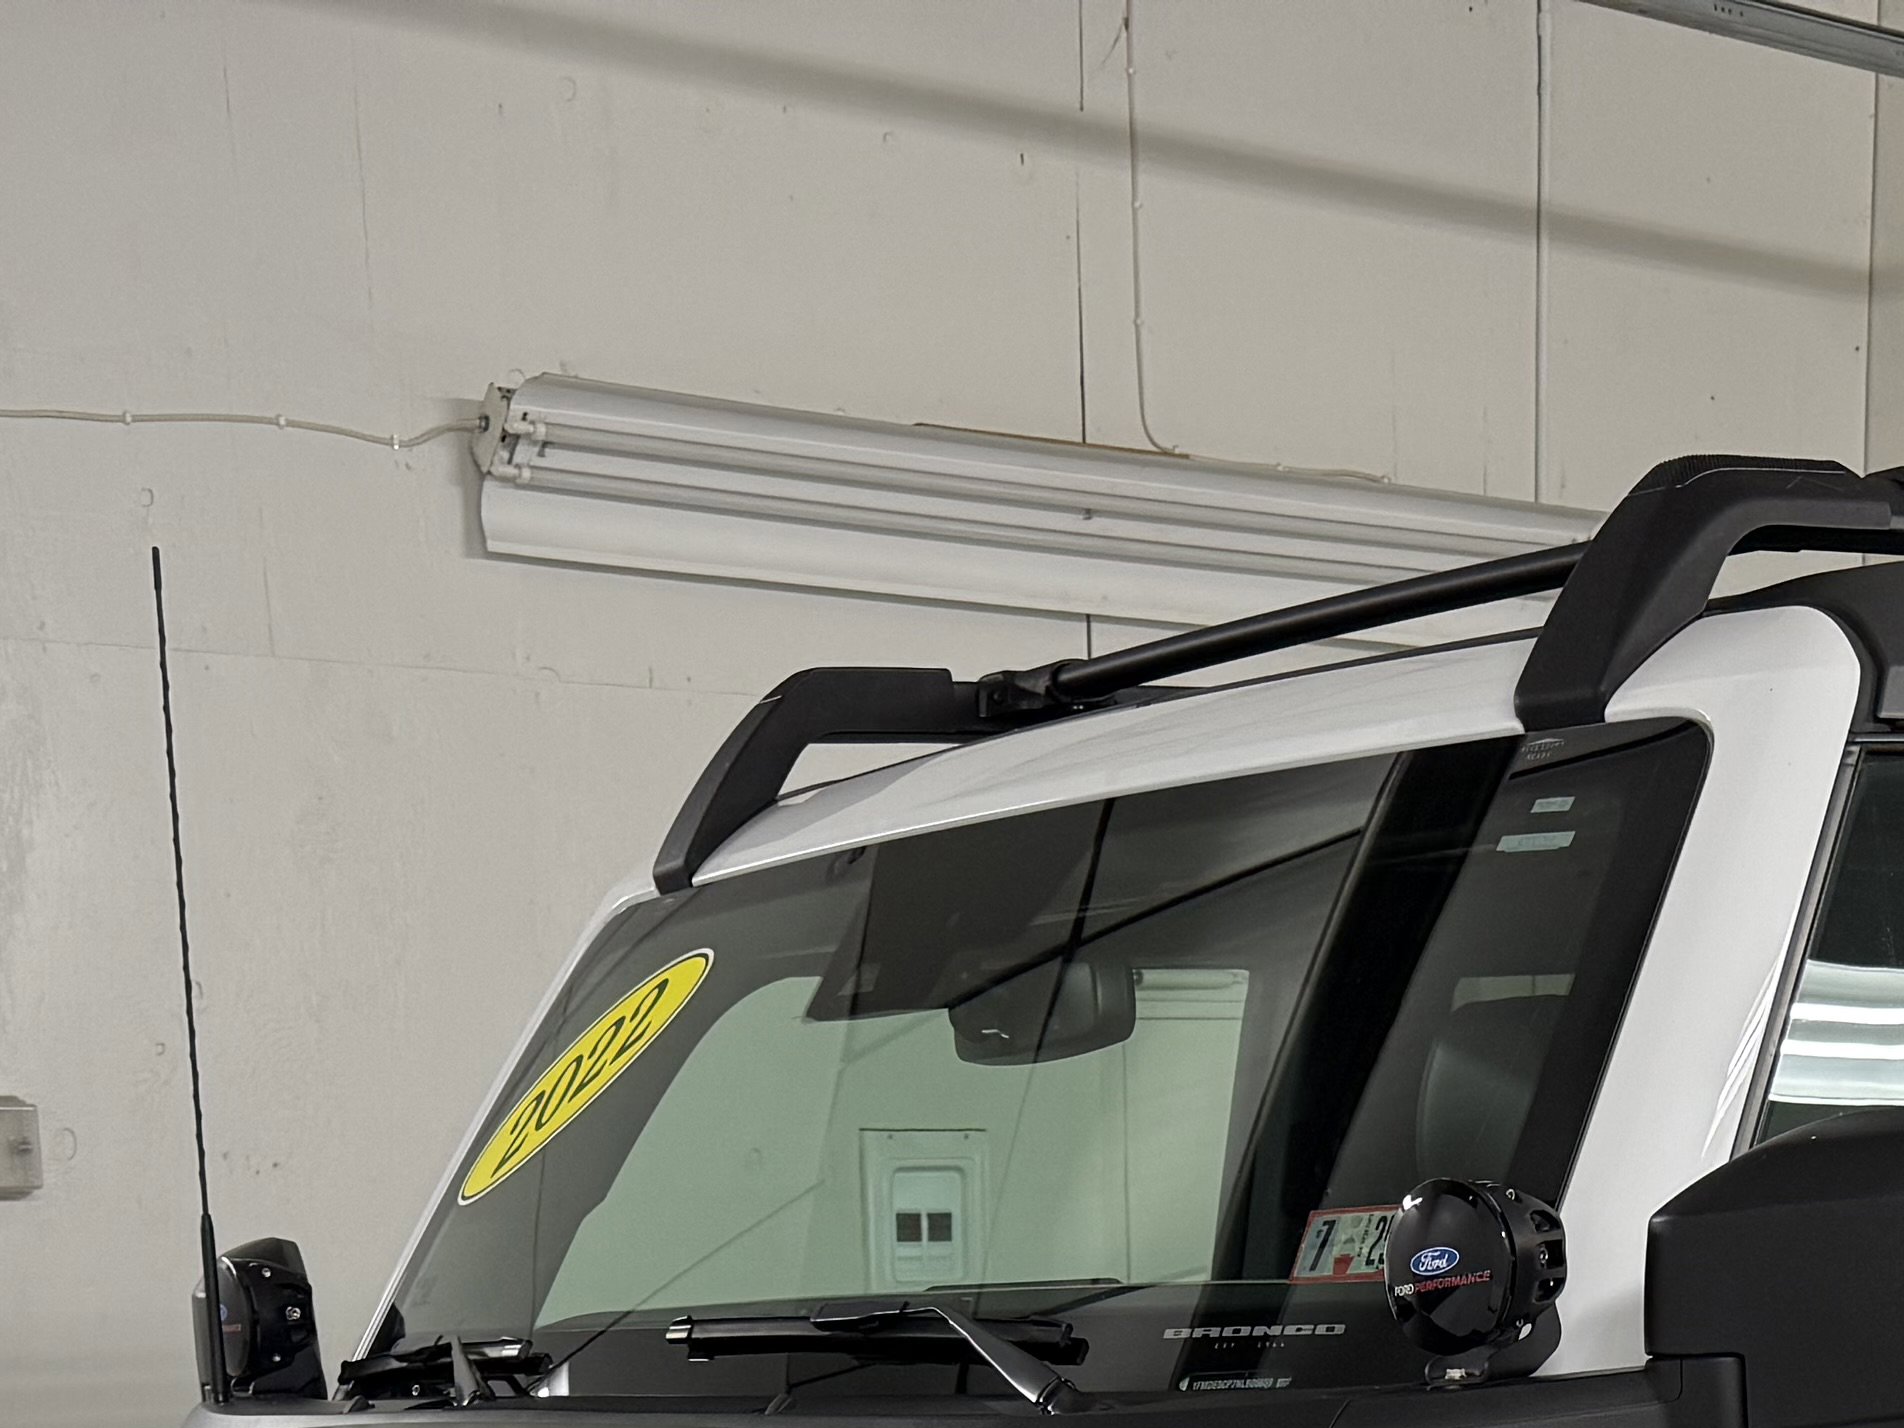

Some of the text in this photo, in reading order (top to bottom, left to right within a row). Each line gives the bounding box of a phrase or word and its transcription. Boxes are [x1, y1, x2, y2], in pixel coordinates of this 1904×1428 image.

[490, 977, 670, 1180] 2022
[1309, 1219, 1337, 1272] 7
[1418, 1251, 1449, 1271] Ford
[1414, 1270, 1491, 1295] PERFORMANCE
[1163, 1324, 1346, 1339] BRONCO
